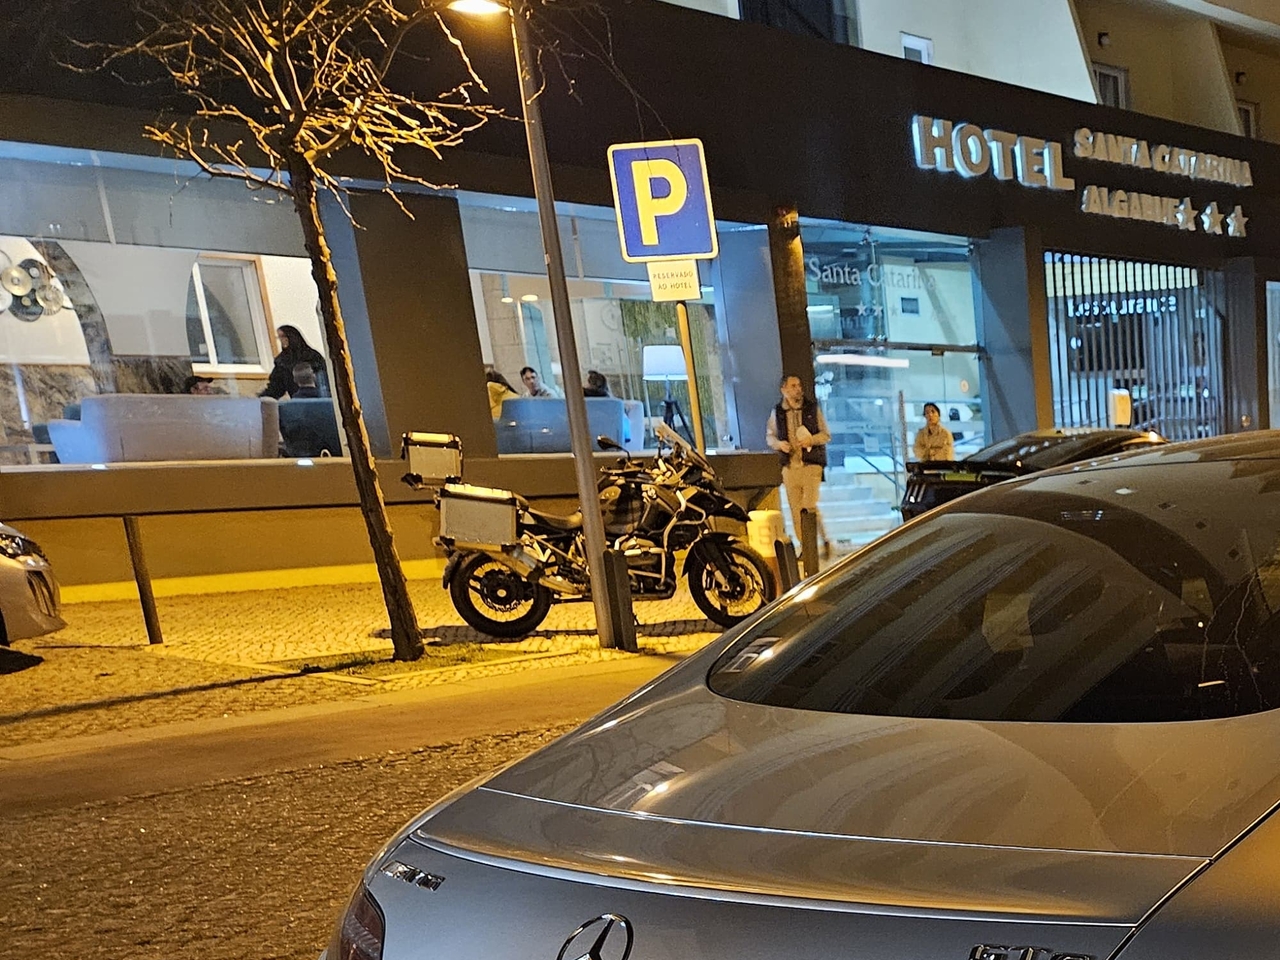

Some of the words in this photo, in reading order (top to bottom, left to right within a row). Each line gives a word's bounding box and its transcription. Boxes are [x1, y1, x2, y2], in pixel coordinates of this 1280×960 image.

[912, 114, 1075, 190] HOTEL
[1074, 127, 1151, 168] SANTA
[1152, 144, 1253, 187] CATARINA
[631, 158, 687, 246] P
[1081, 185, 1180, 225] ALGARVE
[653, 270, 693, 279] RESERVADO
[670, 282, 692, 290] HOTEL
[809, 258, 861, 286] Santa
